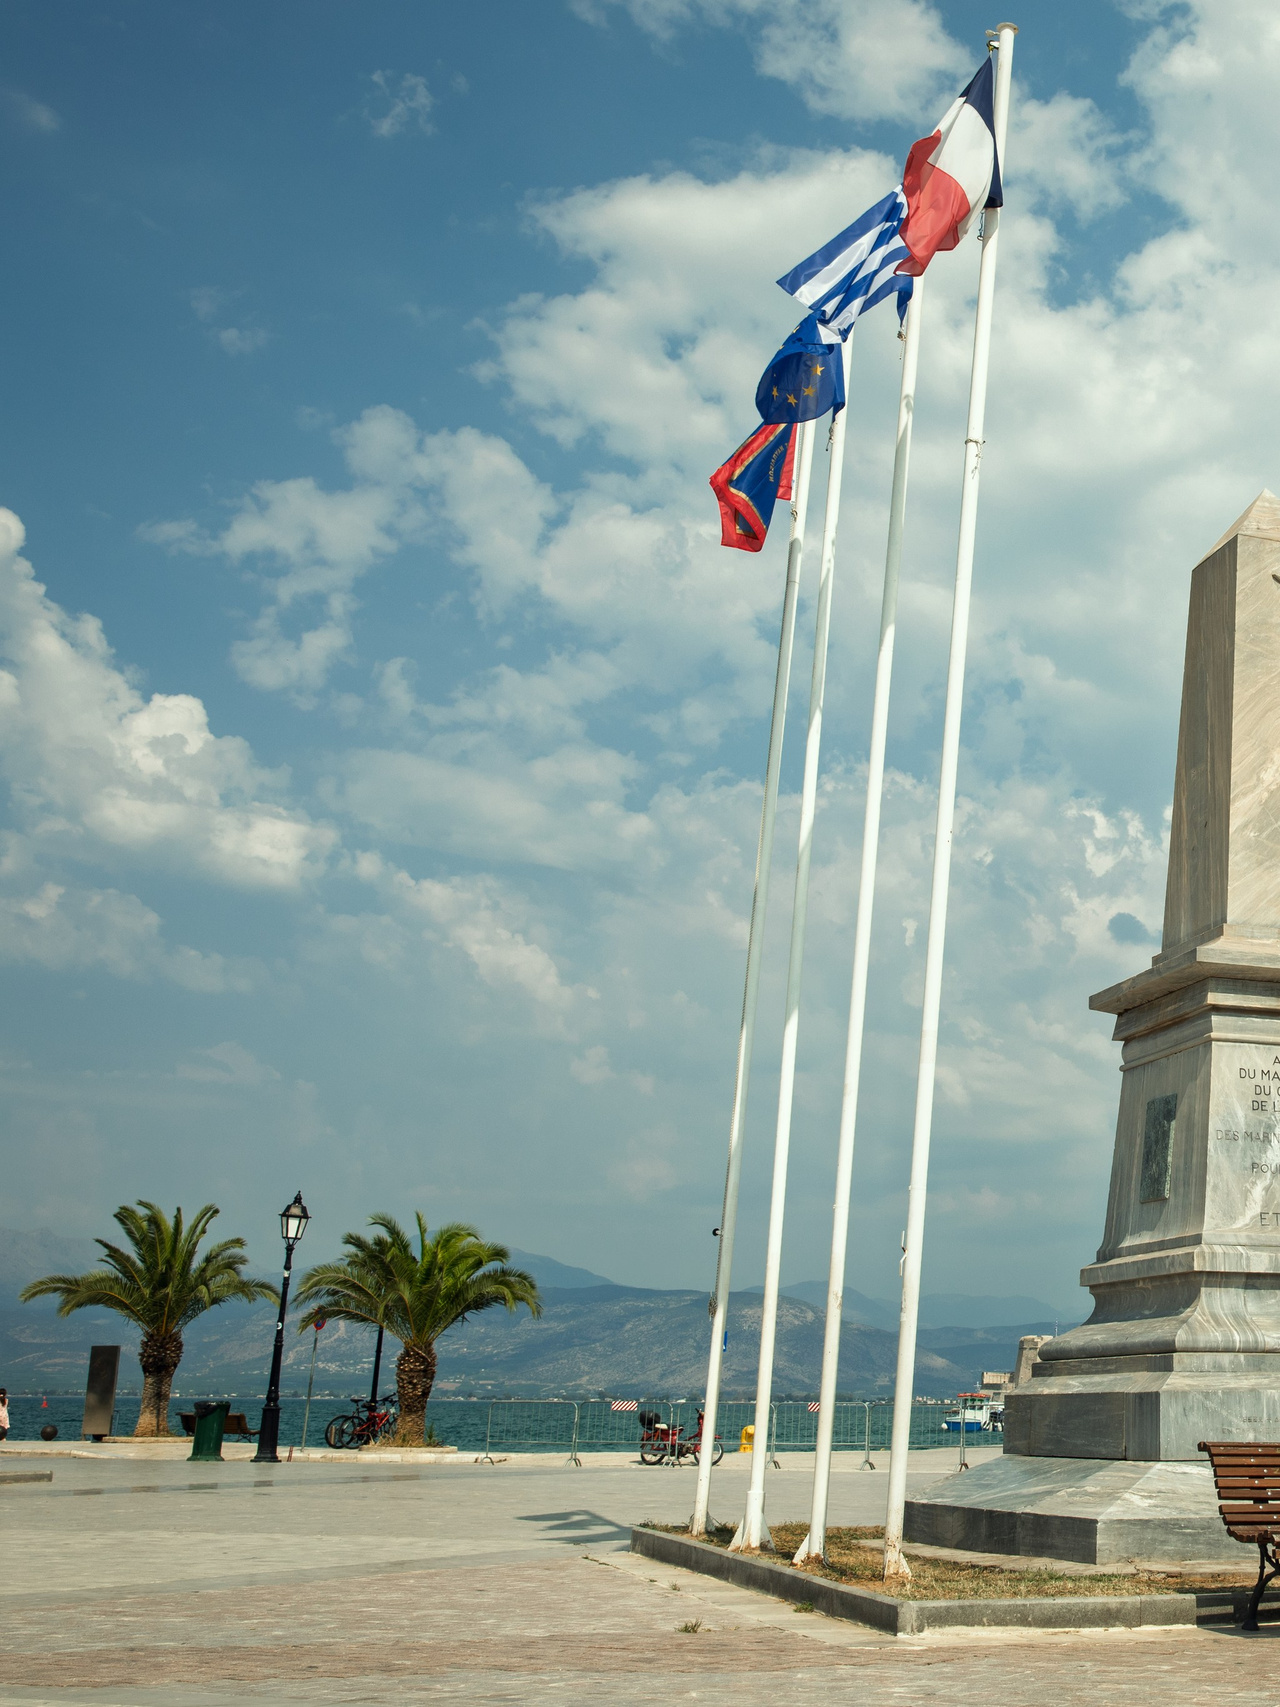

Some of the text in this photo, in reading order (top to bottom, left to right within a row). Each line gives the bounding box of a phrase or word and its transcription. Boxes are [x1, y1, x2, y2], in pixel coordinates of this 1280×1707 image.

[1239, 1067, 1256, 1079] DU
[1254, 1084, 1271, 1096] DU
[1252, 1100, 1268, 1111] DE
[1216, 1130, 1239, 1141] DES
